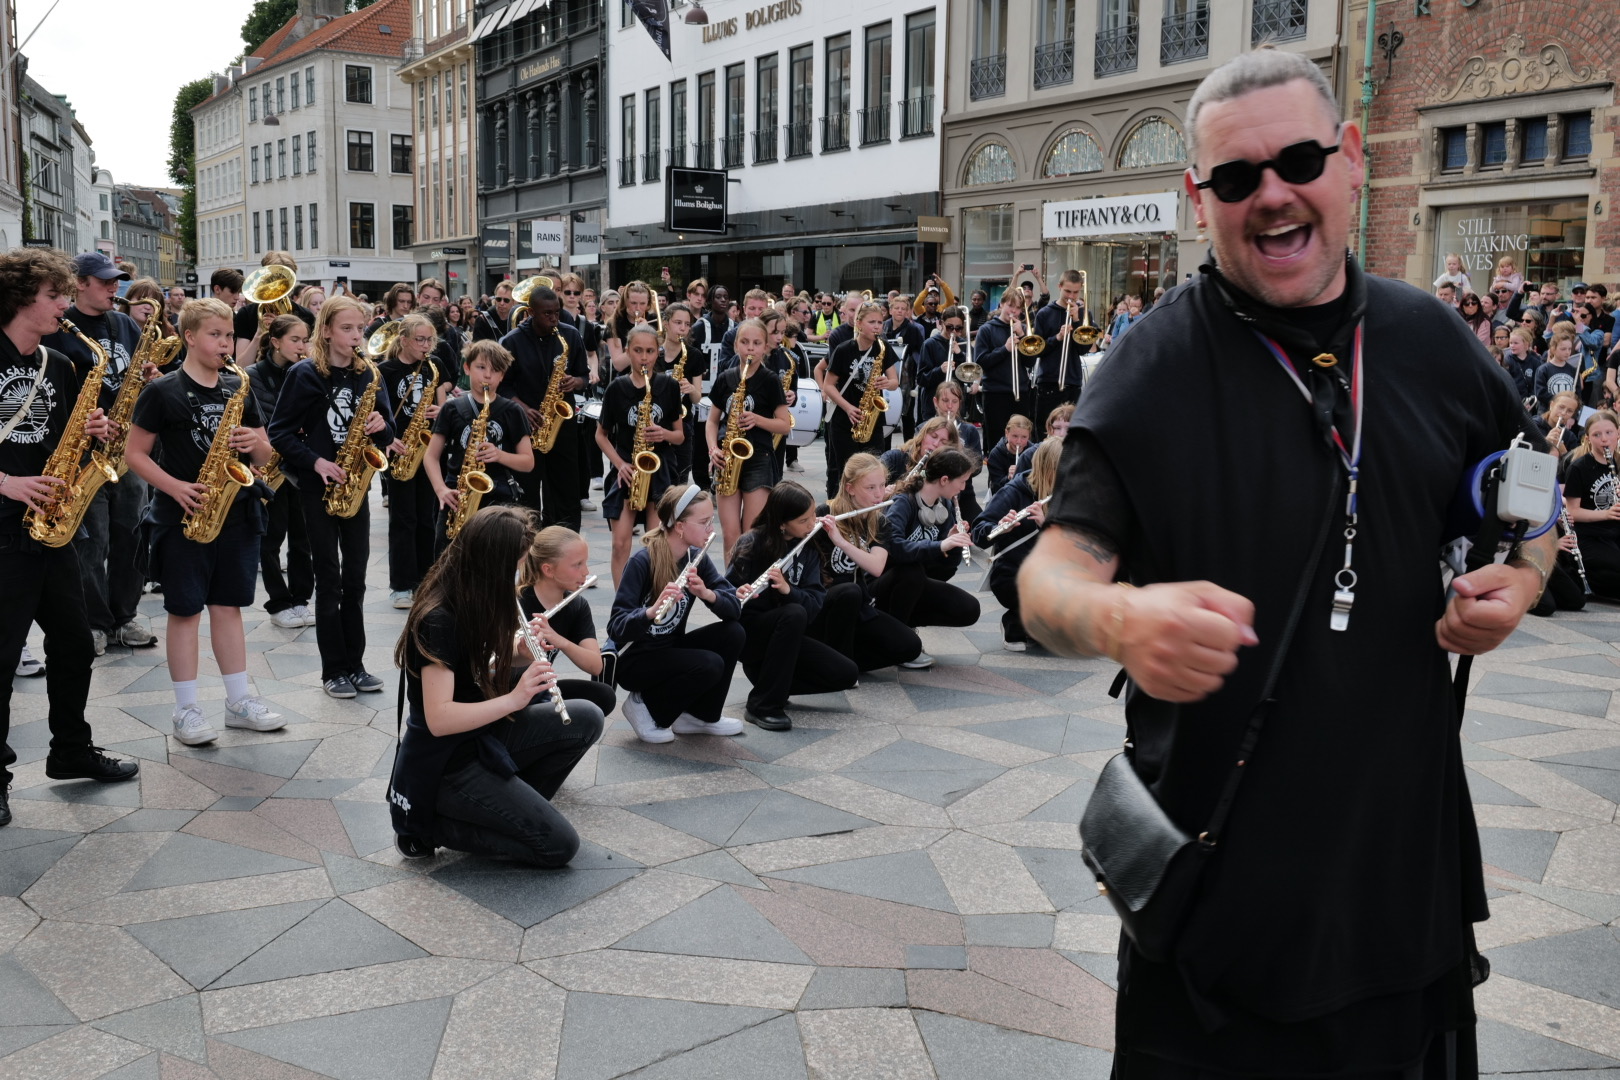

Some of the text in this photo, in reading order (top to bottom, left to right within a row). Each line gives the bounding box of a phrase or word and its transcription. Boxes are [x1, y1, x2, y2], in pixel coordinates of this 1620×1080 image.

[702, 0, 803, 44] ILLUMS BOLIGHUS
[520, 68, 529, 80] Ole
[550, 56, 560, 69] Hus
[674, 199, 723, 210] Illums Bolighus
[1593, 202, 1602, 215] 6
[1054, 203, 1161, 229] TIFFANY&CO.
[1413, 213, 1421, 226] 6
[1457, 218, 1496, 236] STILL
[483, 239, 509, 248] ALIS
[536, 232, 561, 242] RAINS
[1464, 233, 1529, 254] MAKING
[431, 250, 443, 259] GAN
[27, 367, 56, 397] SKLES
